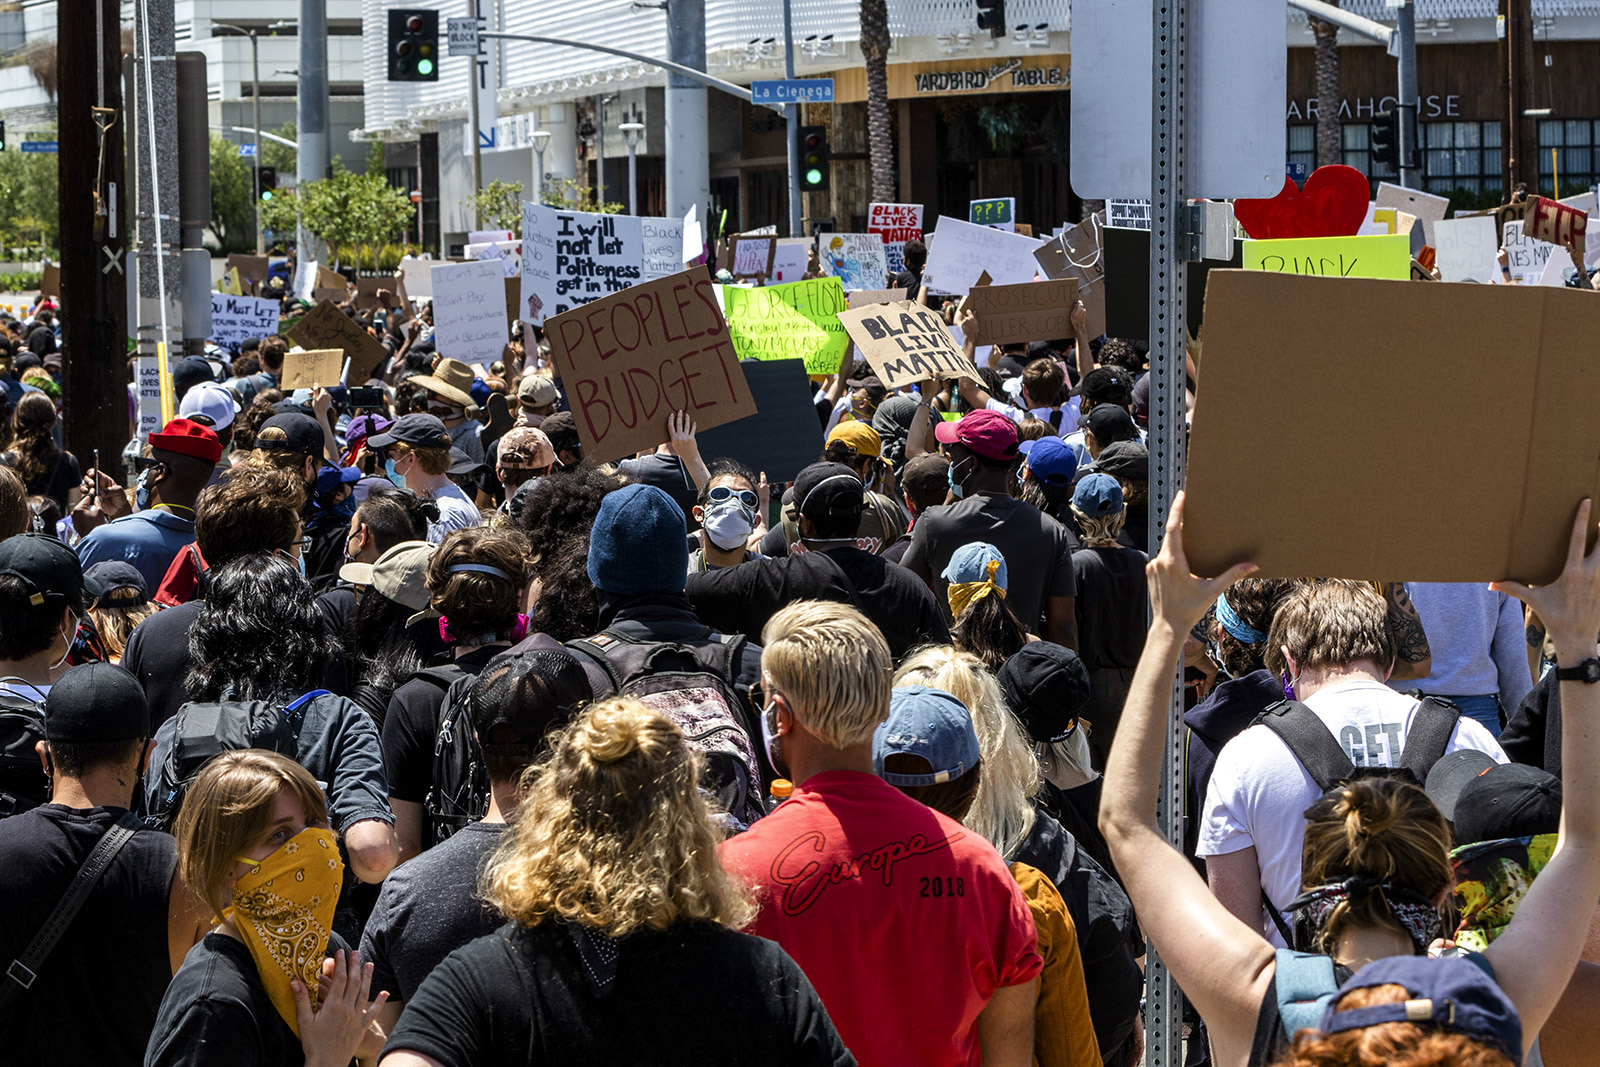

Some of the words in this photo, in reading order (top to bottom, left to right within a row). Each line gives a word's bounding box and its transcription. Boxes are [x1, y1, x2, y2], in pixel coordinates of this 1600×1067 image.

[915, 69, 989, 92] YARDBIRD
[1010, 67, 1061, 87] TABLE
[754, 84, 770, 98] La
[776, 82, 833, 100] Cienega
[523, 208, 538, 224] No
[872, 205, 917, 217] BLACK
[557, 215, 574, 236] I
[577, 217, 615, 237] will
[871, 216, 917, 227] LIVES
[643, 224, 682, 239] Black
[868, 227, 922, 244] MATTER
[526, 245, 542, 261] No
[556, 237, 592, 255] not
[598, 235, 623, 255] let
[641, 242, 675, 257] Lives
[556, 255, 641, 279] Politeness
[642, 258, 680, 272] Matter
[556, 276, 583, 295] get
[586, 277, 601, 292] in
[729, 284, 801, 320] GEORGE
[559, 275, 724, 371] PEOPLE'S
[734, 336, 768, 351] TONY
[575, 341, 738, 444] BUDGET
[770, 830, 966, 917] Europe
[919, 876, 965, 898] 2018
